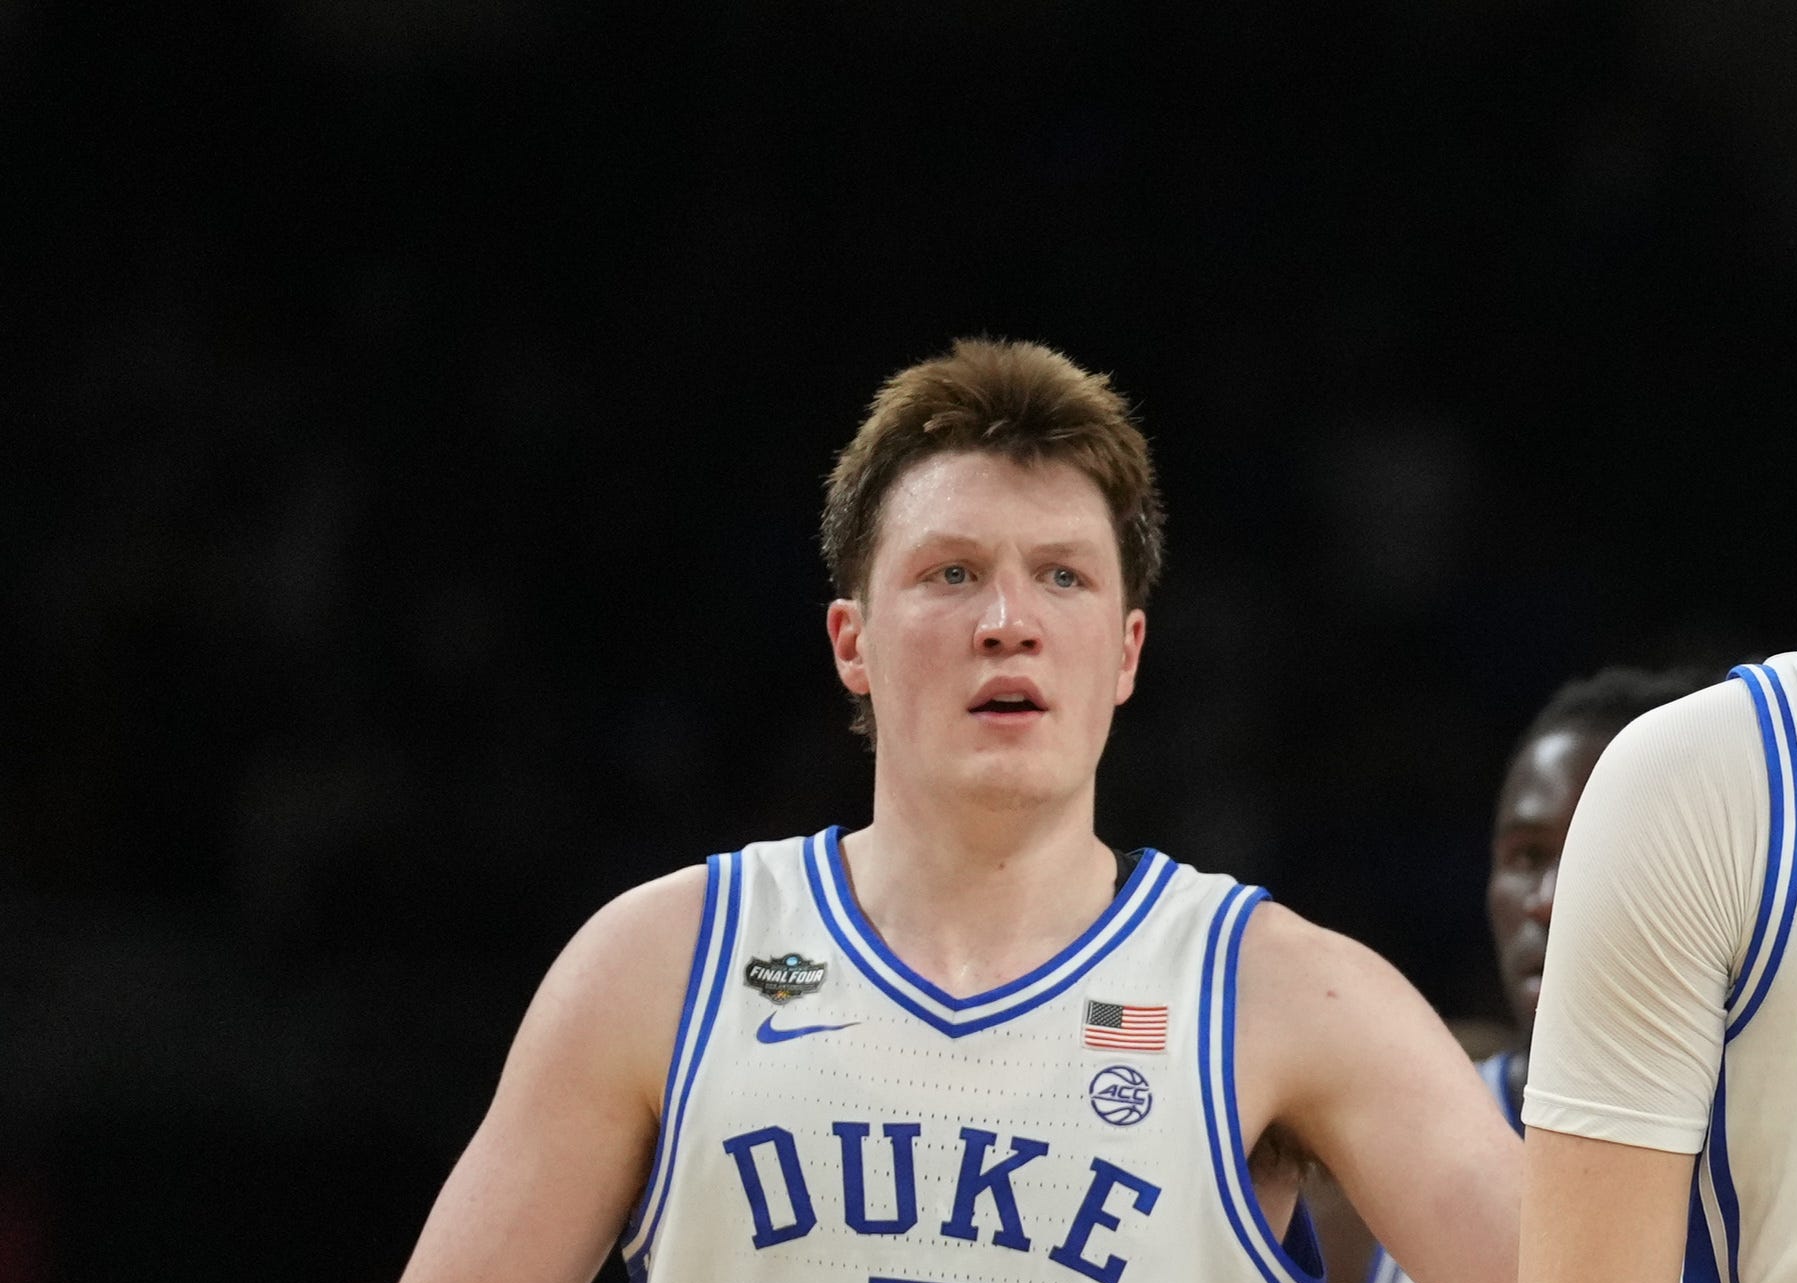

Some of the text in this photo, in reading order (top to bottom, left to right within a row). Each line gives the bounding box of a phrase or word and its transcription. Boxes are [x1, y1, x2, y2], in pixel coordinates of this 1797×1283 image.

[750, 966, 824, 984] FINAL FOUR
[1098, 1084, 1149, 1101] ACC
